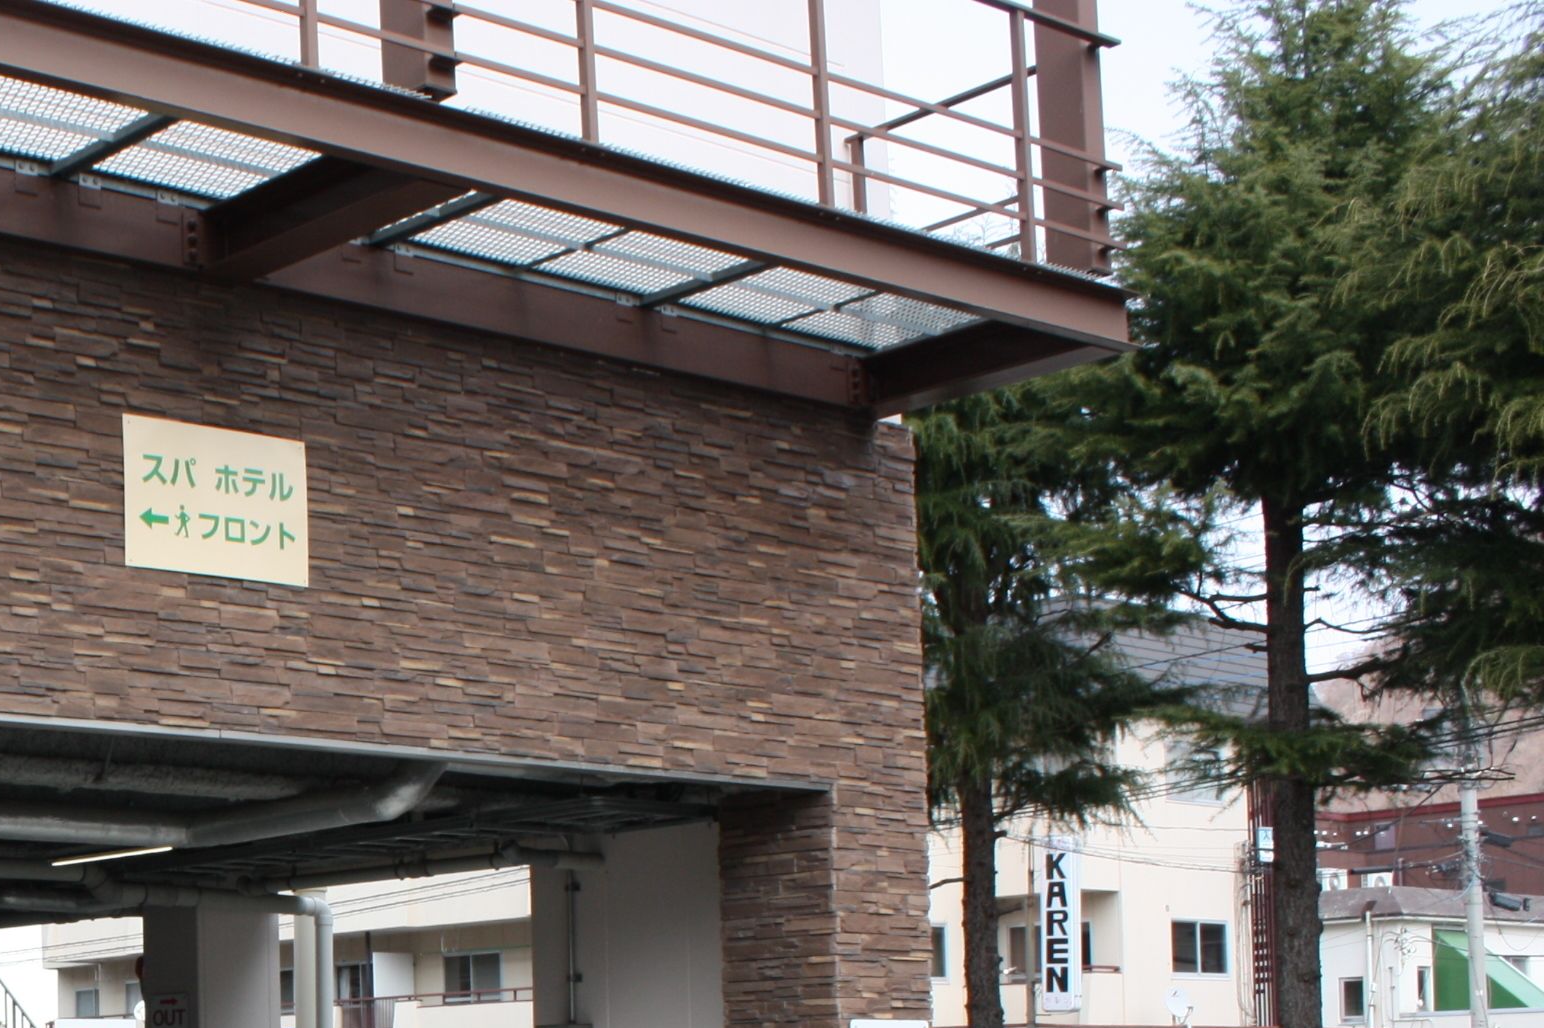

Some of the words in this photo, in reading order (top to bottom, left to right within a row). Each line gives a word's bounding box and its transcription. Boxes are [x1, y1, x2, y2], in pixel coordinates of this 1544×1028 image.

[142, 453, 196, 488] スパ
[215, 464, 293, 501] ホテル
[198, 512, 296, 550] フロント
[1045, 852, 1069, 993] KAREN
[153, 1008, 186, 1027] OUT
